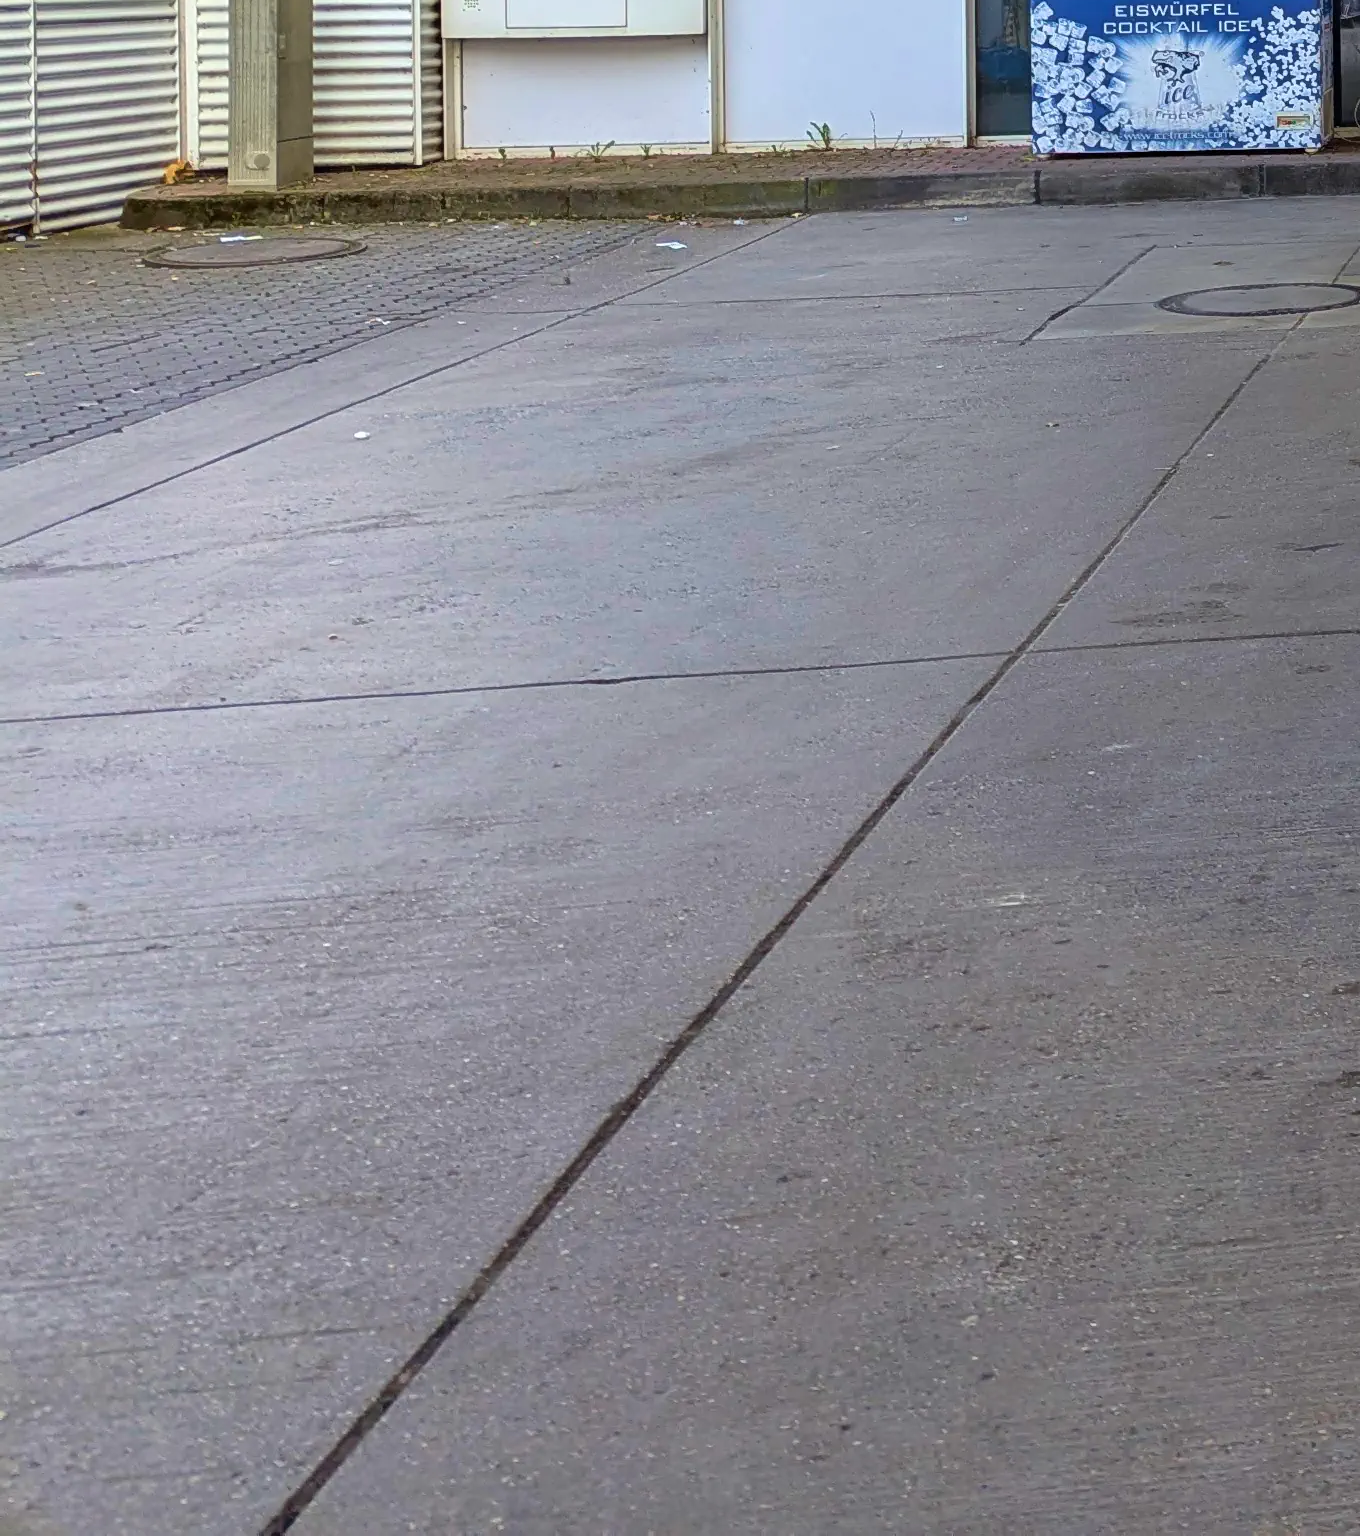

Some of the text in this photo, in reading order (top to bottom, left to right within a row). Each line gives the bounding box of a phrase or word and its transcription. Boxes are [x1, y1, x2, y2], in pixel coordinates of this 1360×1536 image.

[1115, 1, 1239, 18] EISWÜRFEL
[1103, 19, 1251, 34] COCKTAIL ICE
[1164, 82, 1194, 105] ice
